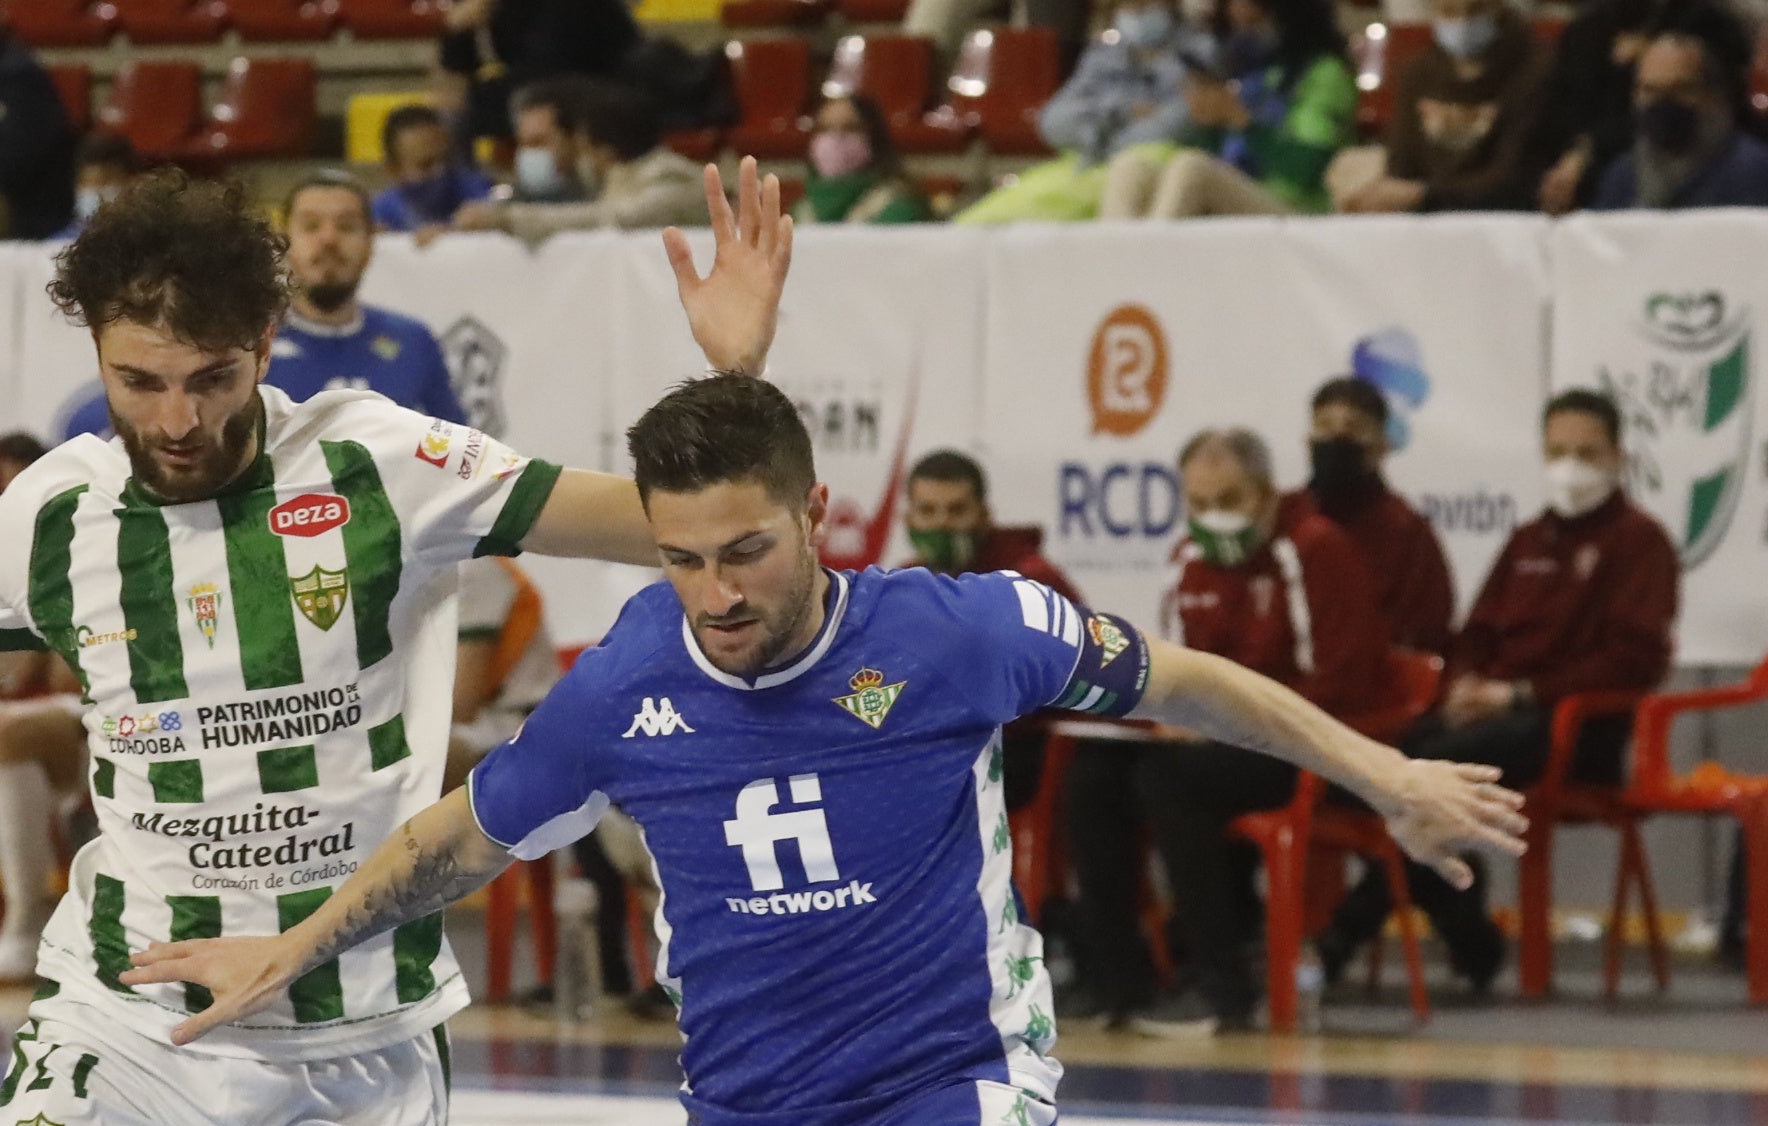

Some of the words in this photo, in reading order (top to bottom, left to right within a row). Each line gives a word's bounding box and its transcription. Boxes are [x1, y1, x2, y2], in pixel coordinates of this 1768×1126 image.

[1058, 461, 1183, 539] RCD
[197, 687, 345, 725] PATRIMONIO
[202, 705, 362, 750] HUMANIDAD
[132, 803, 321, 843] Mezquita-
[722, 772, 841, 892] fi
[189, 823, 356, 869] Catedral
[192, 873, 260, 891] Corazón
[265, 872, 285, 889] de
[290, 860, 359, 886] Córdoba
[725, 880, 878, 917] network
